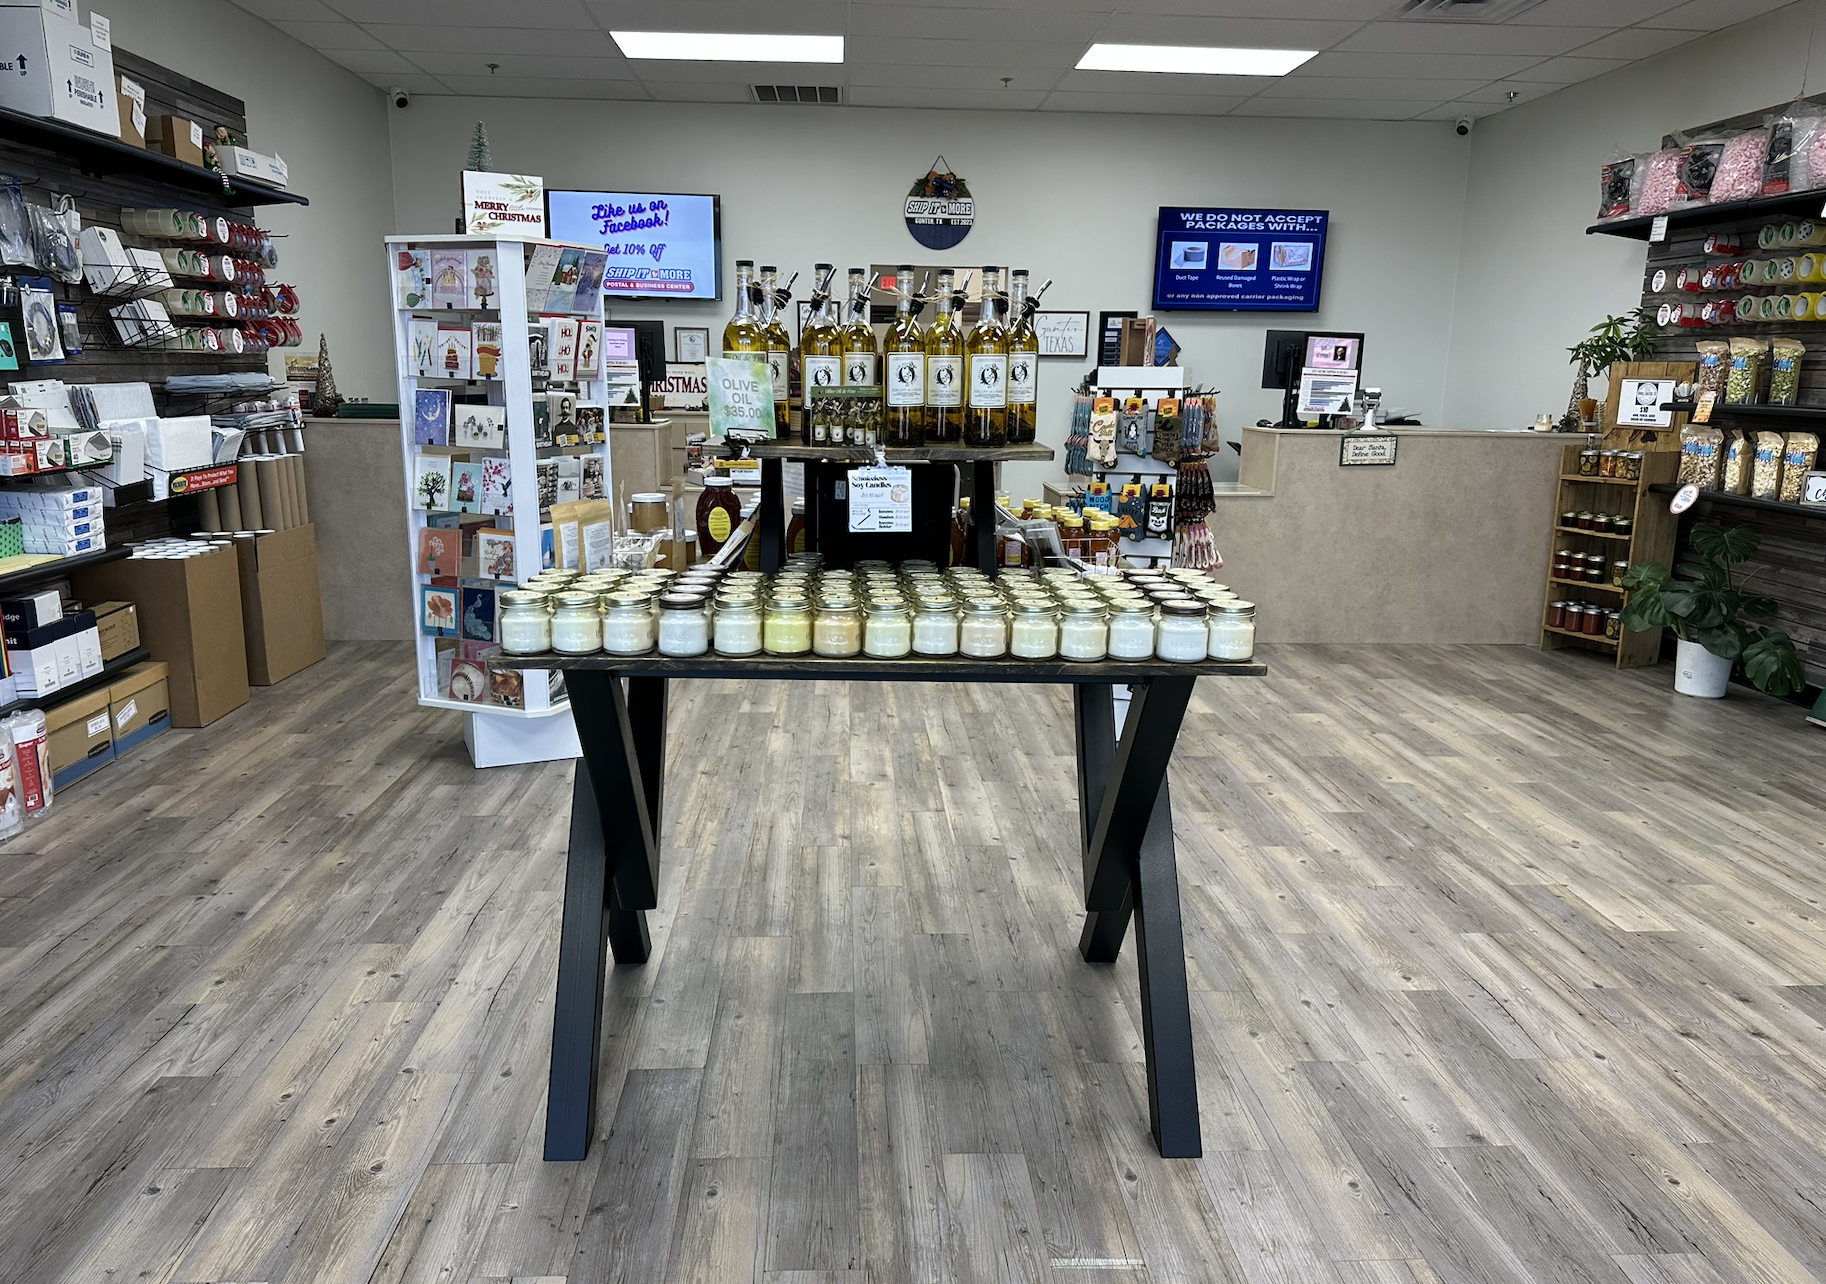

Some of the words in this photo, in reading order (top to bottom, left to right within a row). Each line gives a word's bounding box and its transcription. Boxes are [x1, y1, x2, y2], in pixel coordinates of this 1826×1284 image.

[474, 200, 508, 212] MERRY
[591, 203, 626, 220] Like
[628, 202, 646, 215] us
[650, 200, 668, 212] on
[907, 200, 929, 214] SHIP
[928, 202, 941, 214] IT
[948, 202, 972, 216] MORE
[599, 210, 670, 235] Facebook!
[1180, 212, 1203, 221] WE
[1206, 213, 1228, 222] DO
[1230, 214, 1262, 222] NOT
[1265, 214, 1323, 224] ACCEPT
[1186, 221, 1264, 230] PACKAGES
[1268, 222, 1318, 232] WITH...
[622, 244, 646, 255] 10%
[650, 244, 666, 262] Off
[606, 266, 636, 278] SHIP
[636, 268, 650, 279] IT
[659, 268, 692, 280] MORE
[1034, 314, 1084, 338] Gunter
[1045, 336, 1074, 353] TEXAS
[650, 376, 707, 394] HRISTMAS
[722, 378, 759, 392] OLIVE
[732, 392, 752, 404] OIL
[724, 404, 762, 419] $35.00
[852, 482, 863, 490] Soy
